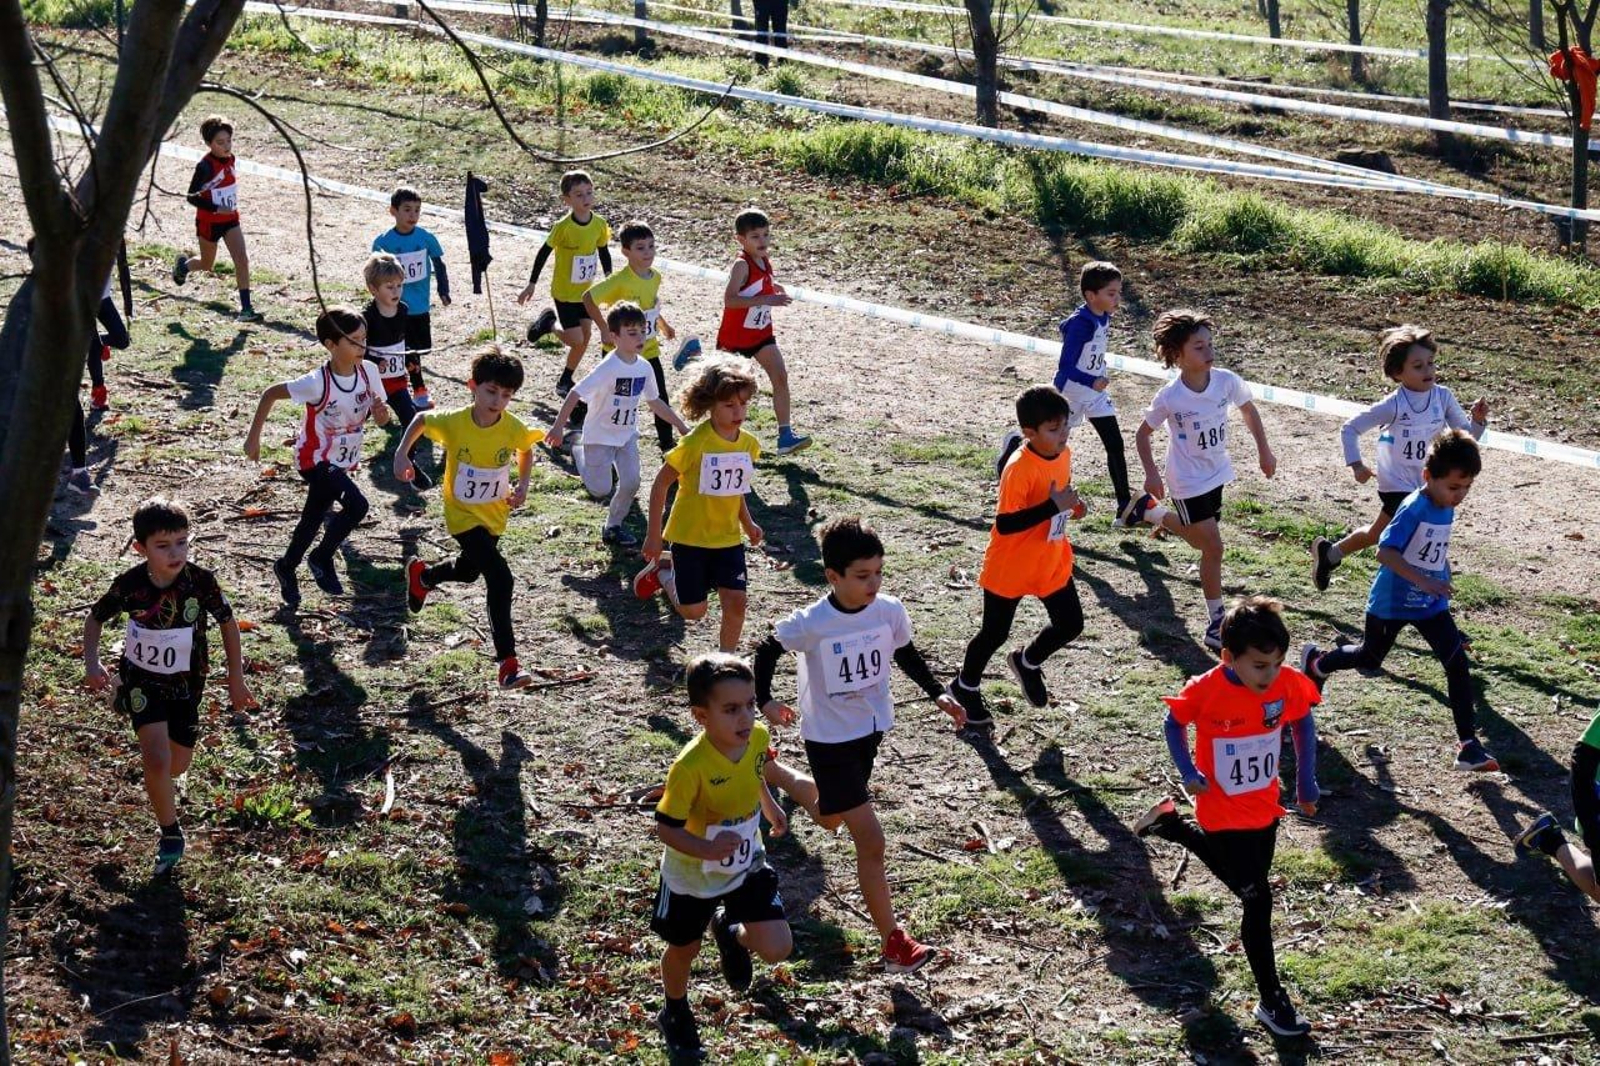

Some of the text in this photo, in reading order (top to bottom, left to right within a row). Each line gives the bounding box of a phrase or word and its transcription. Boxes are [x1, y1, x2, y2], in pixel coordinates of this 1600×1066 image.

[1197, 422, 1226, 451] 486
[1402, 440, 1426, 461] 48
[464, 480, 501, 499] 371
[711, 468, 744, 491] 373
[133, 641, 177, 668] 420
[838, 649, 882, 684] 449
[1229, 751, 1275, 786] 450
